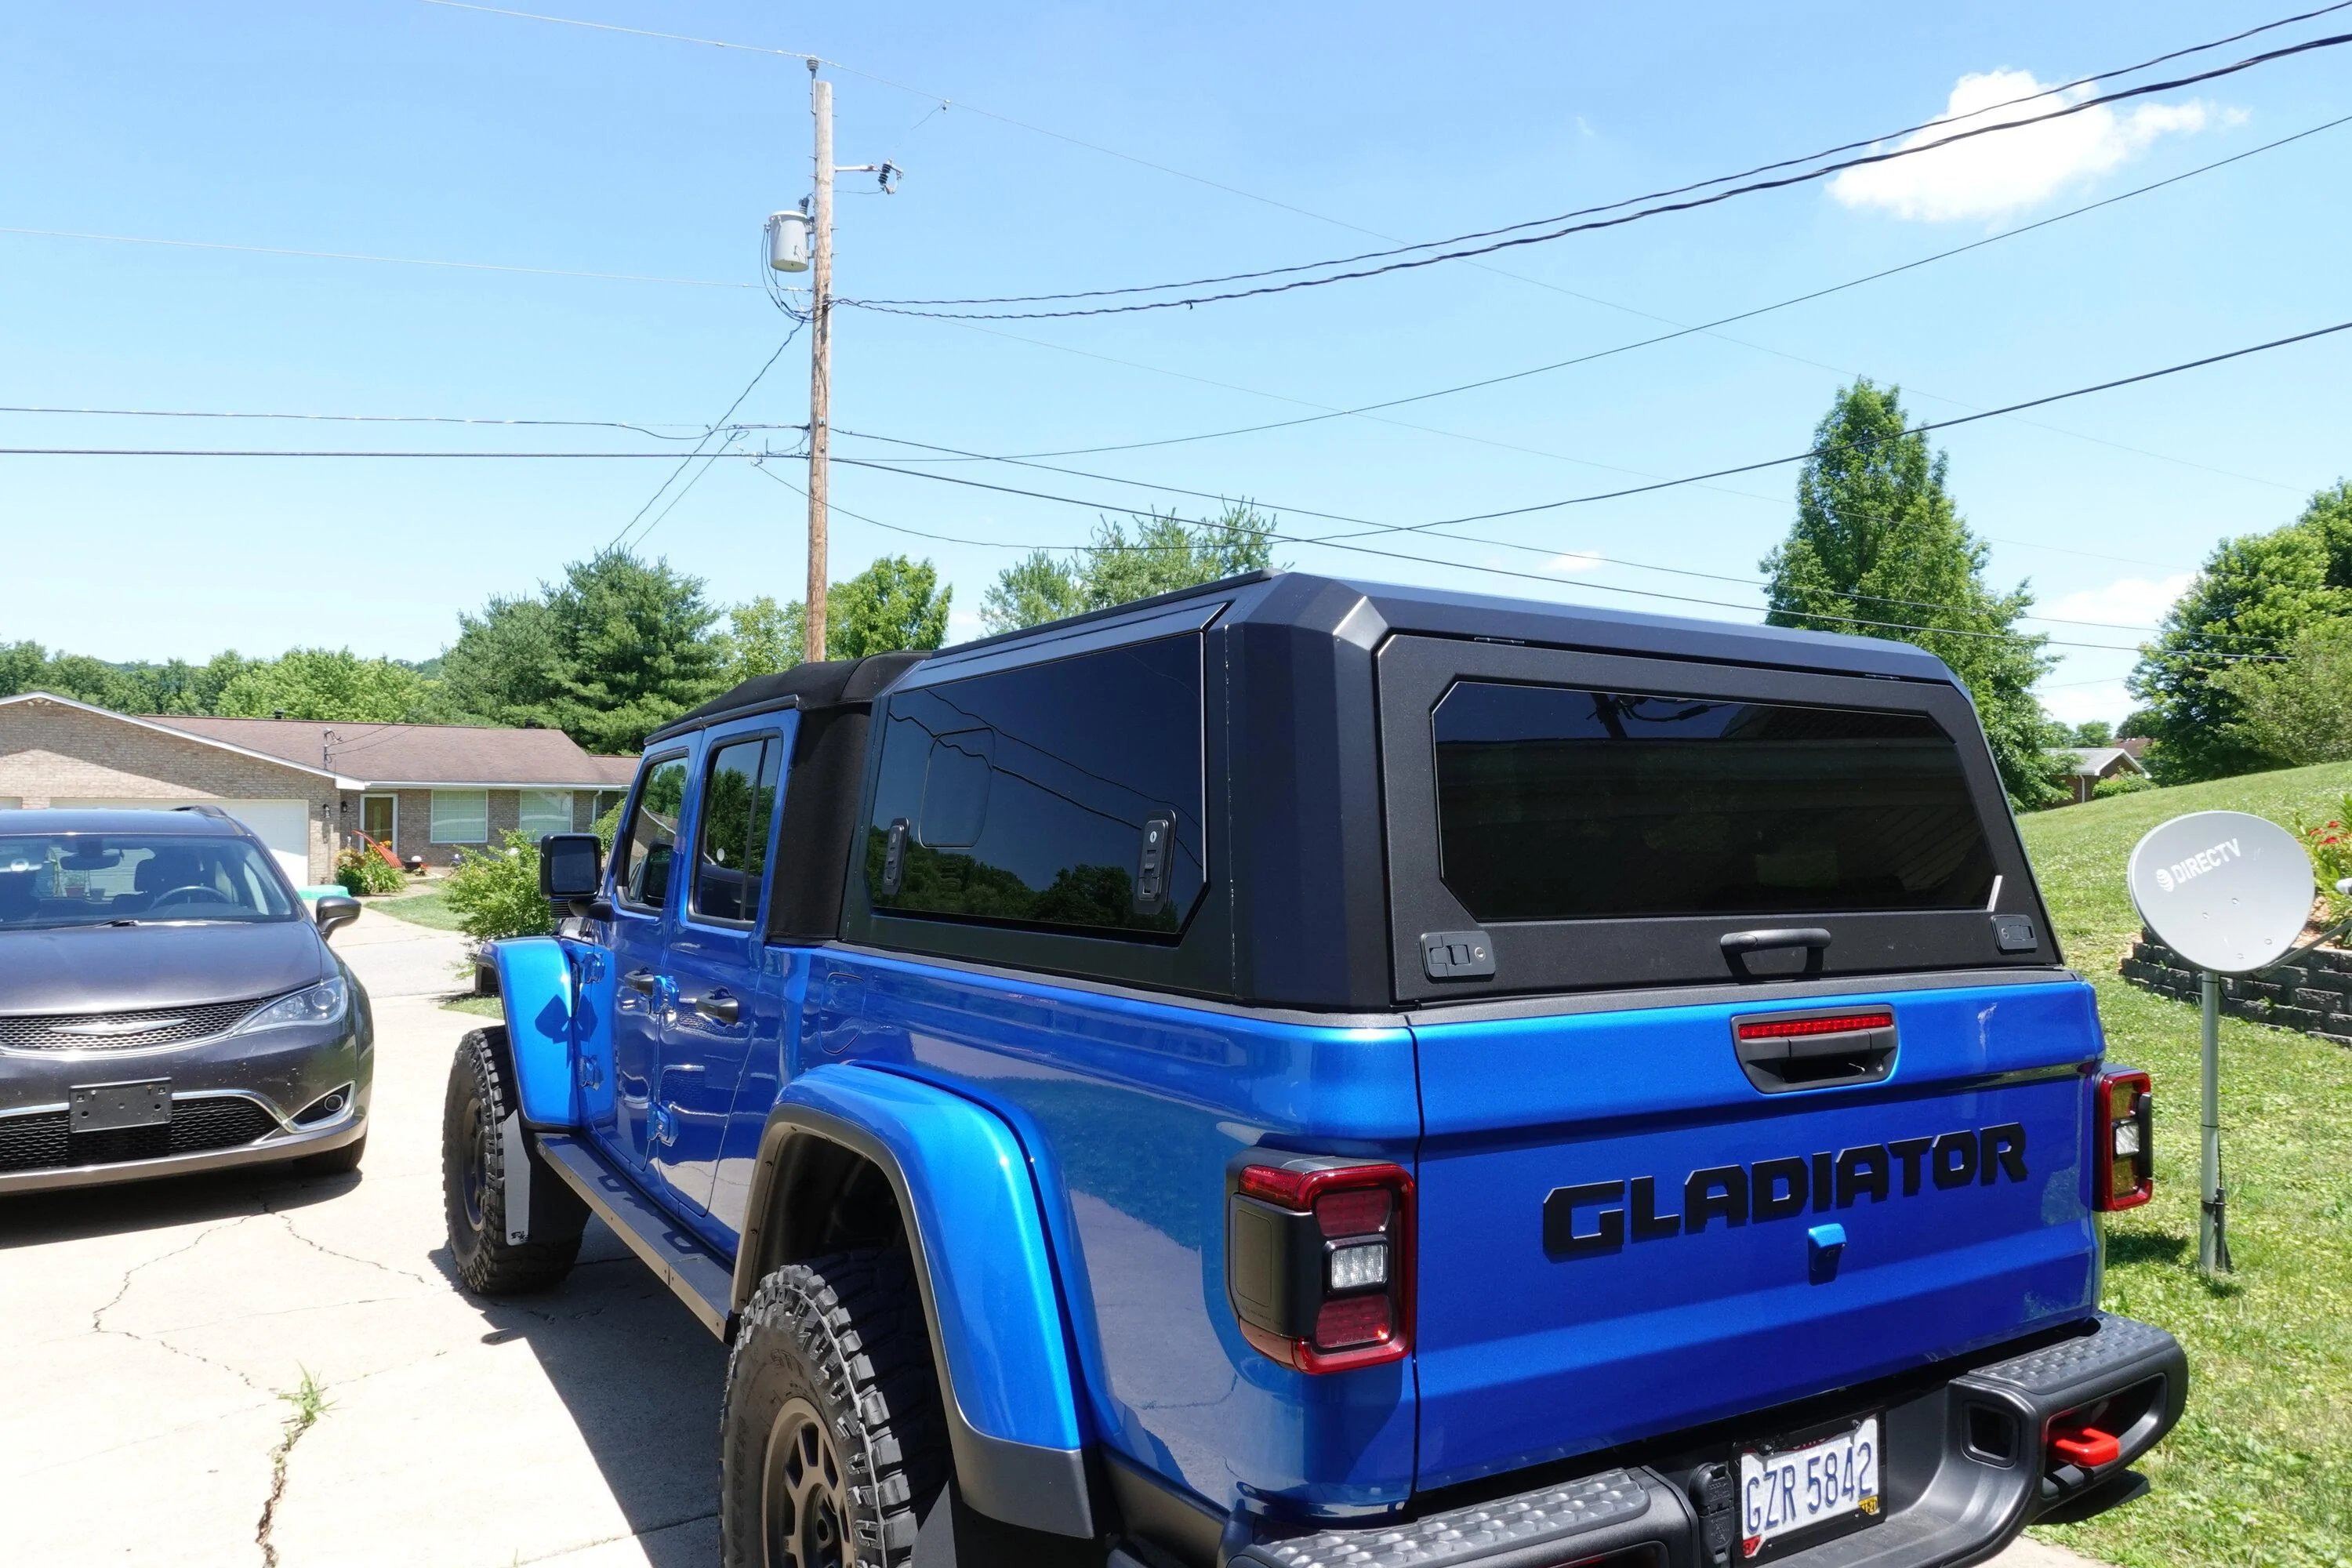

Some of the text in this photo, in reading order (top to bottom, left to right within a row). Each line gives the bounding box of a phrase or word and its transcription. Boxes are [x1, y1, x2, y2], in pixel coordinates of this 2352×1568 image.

[2170, 837, 2241, 884] DIRECTV
[1542, 1122, 2028, 1256] GLADIATOR
[1746, 1441, 1873, 1534] GZR 5842
